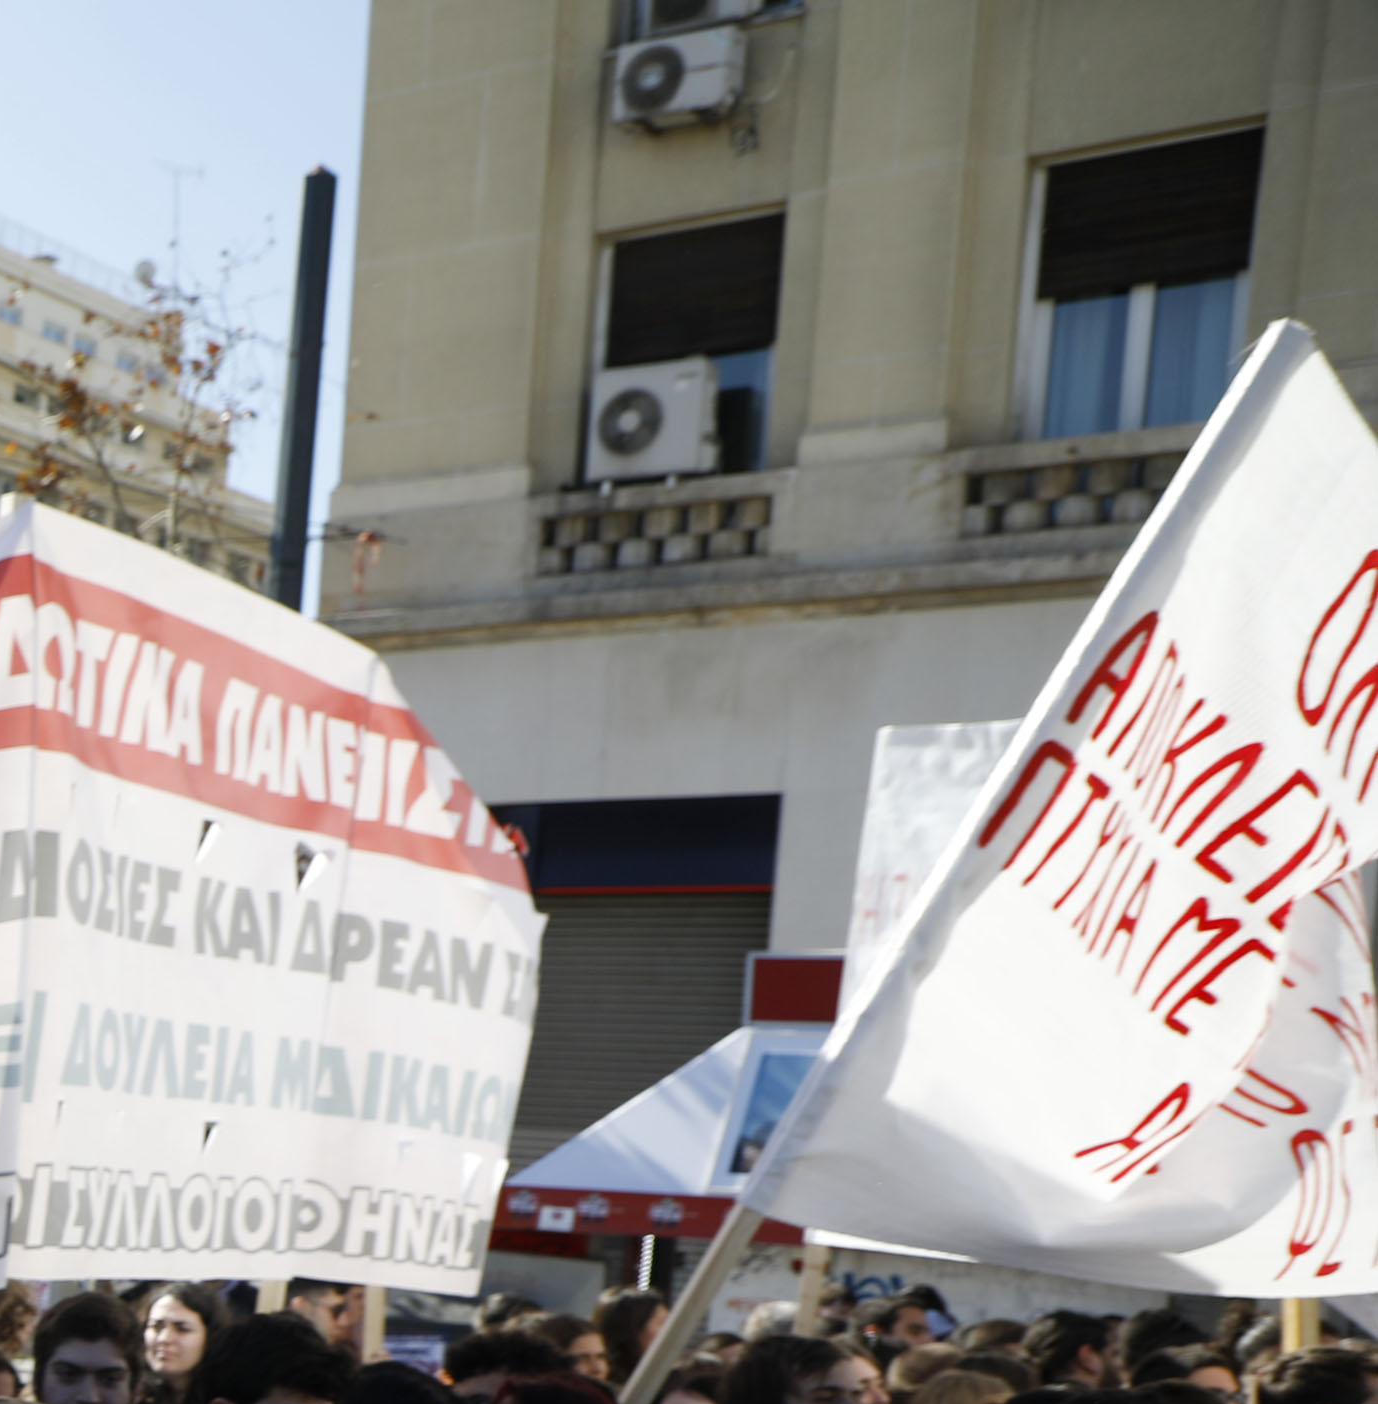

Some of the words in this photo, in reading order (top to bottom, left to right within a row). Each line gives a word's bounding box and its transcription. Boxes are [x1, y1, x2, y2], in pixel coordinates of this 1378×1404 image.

[193, 876, 281, 966] ΚΑΙ
[290, 899, 493, 1010] ΔΡΕΑΝ
[60, 1003, 256, 1107] ΔΟΥΛΕΙΑ
[59, 1165, 295, 1253] ΣΥΛΛΟΓΟΙ
[290, 1178, 484, 1271] ΘΗΝΑΣ
